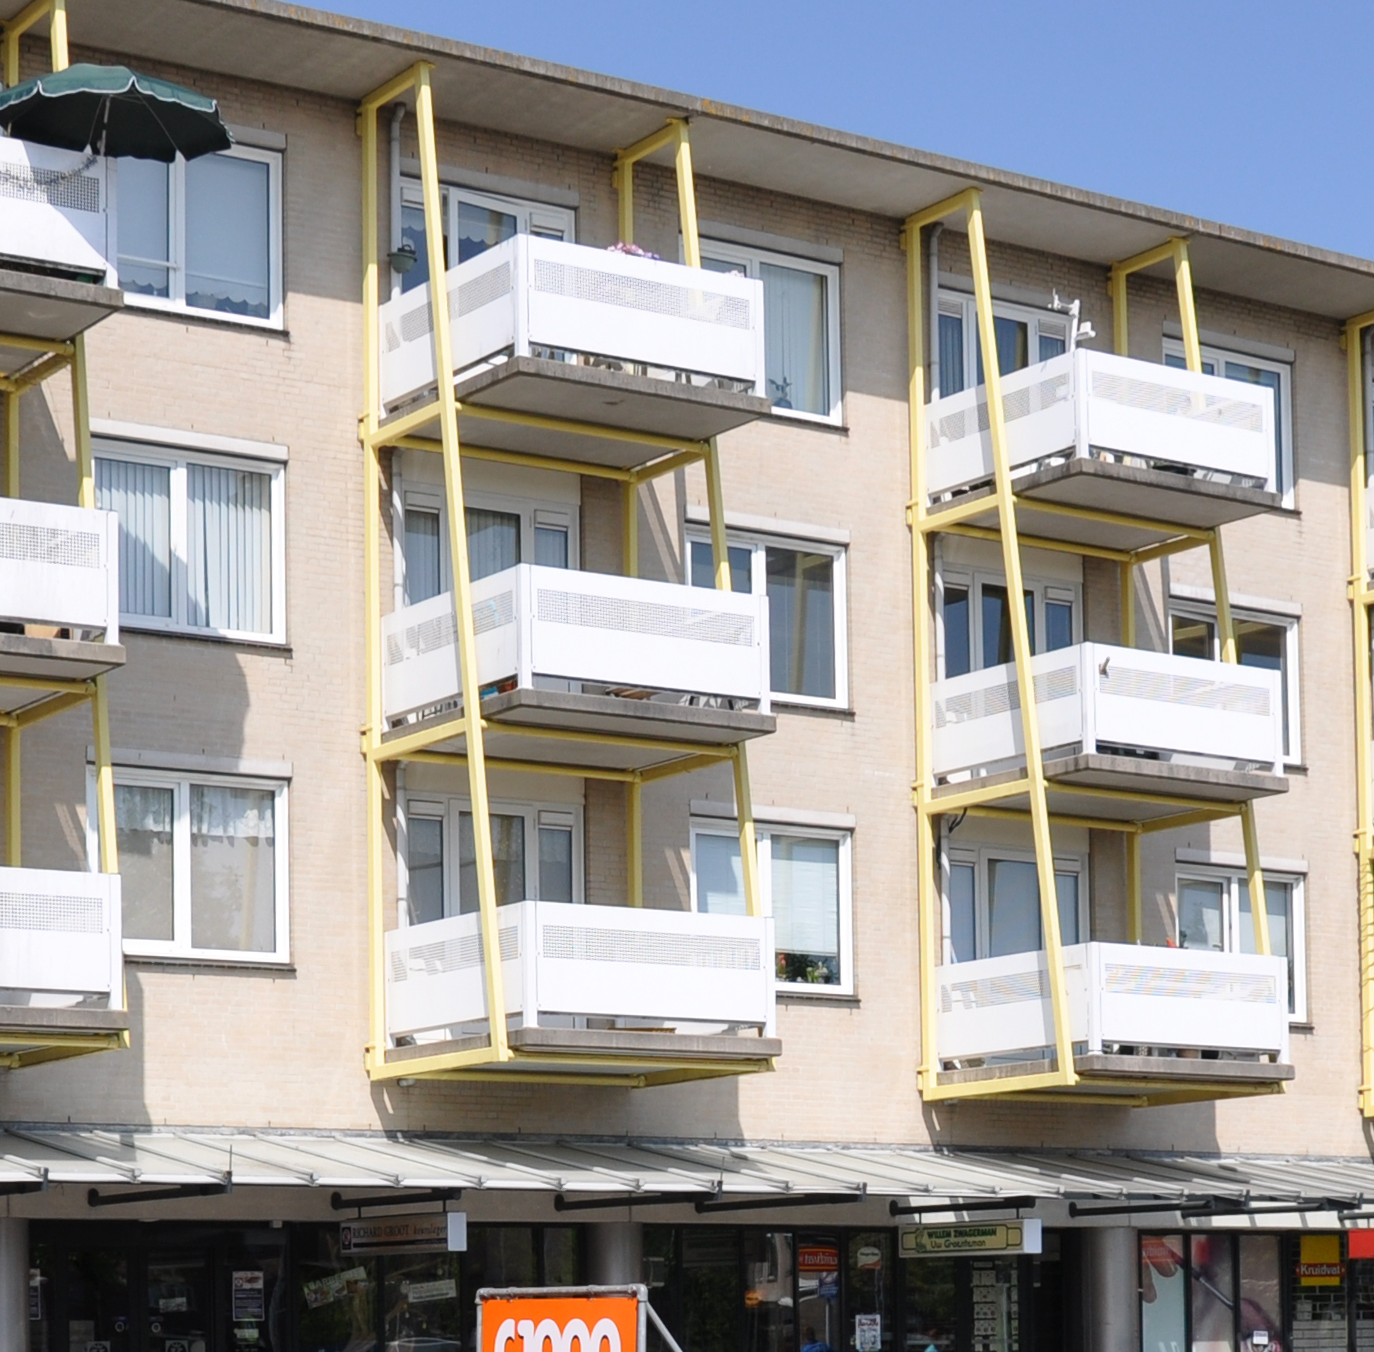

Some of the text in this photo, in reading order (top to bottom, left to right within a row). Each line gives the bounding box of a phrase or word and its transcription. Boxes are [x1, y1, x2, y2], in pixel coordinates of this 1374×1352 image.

[352, 1226, 383, 1239] RICHARD
[384, 1225, 409, 1237] GROOT
[927, 1227, 997, 1239] WILLEM ZWAGERMAN
[1300, 1264, 1340, 1275] Kruidvat
